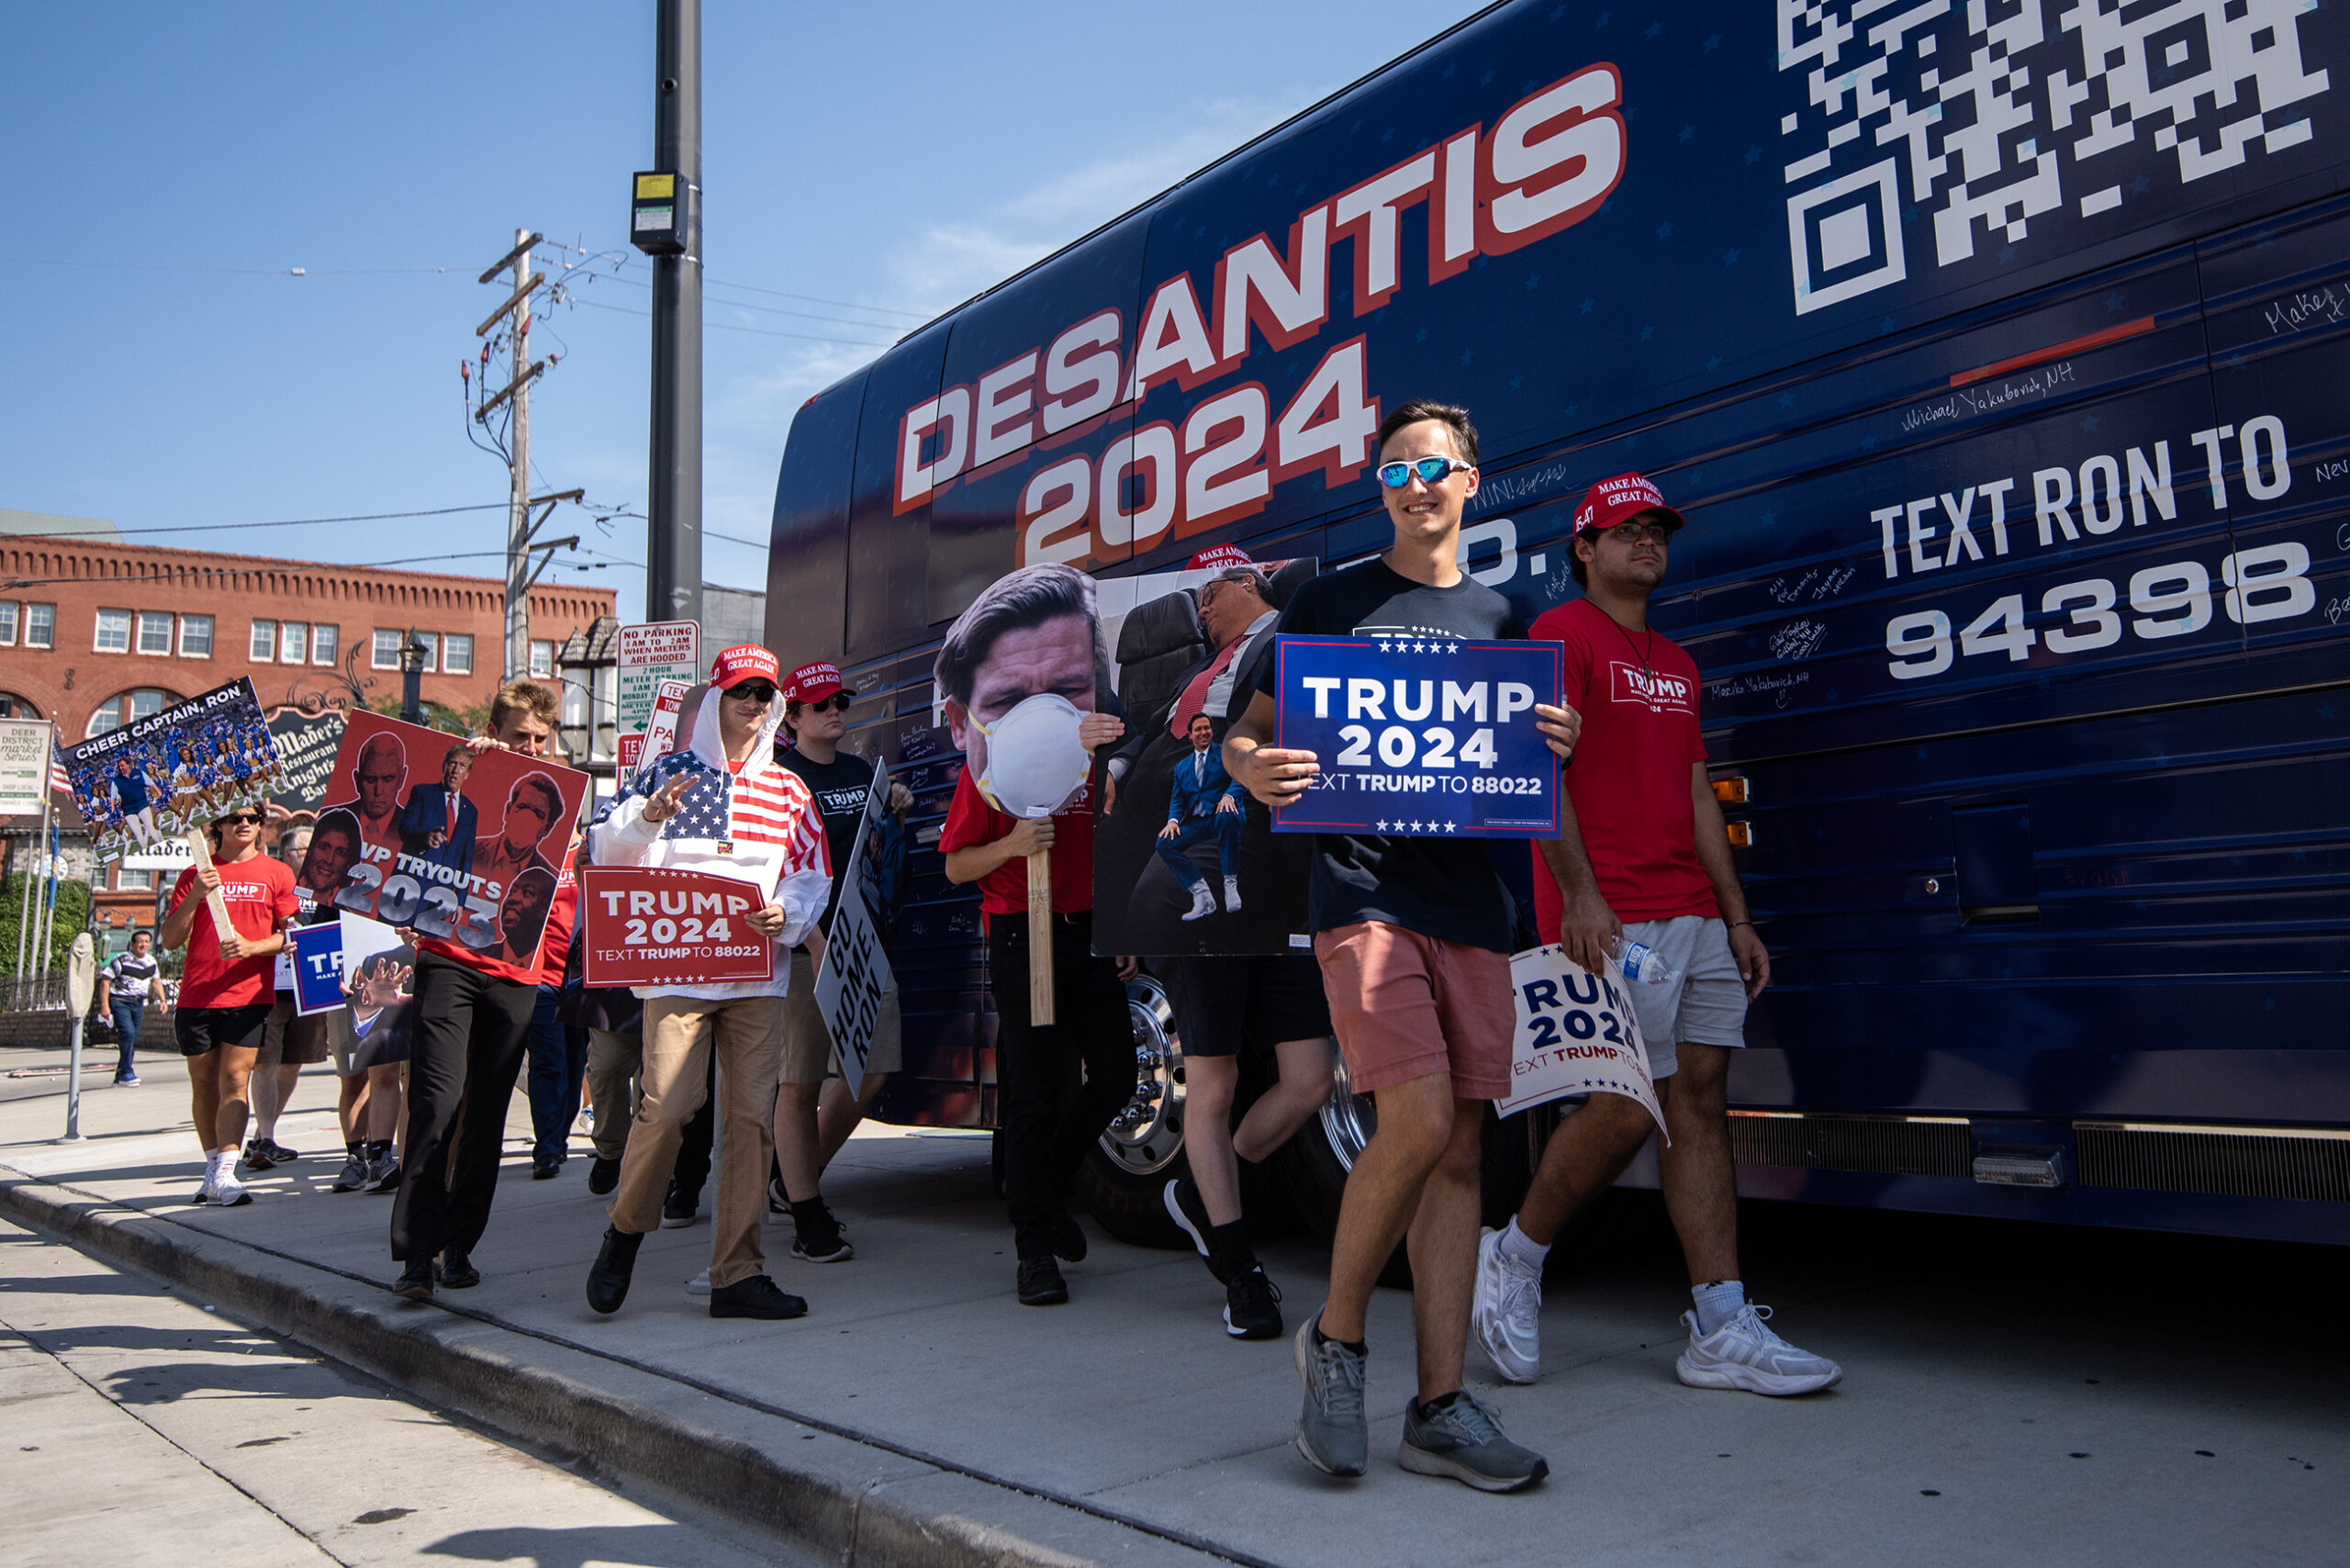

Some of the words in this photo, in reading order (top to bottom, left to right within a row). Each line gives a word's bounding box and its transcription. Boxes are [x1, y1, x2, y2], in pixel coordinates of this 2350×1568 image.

[896, 64, 1625, 510] DESANTIS
[1901, 397, 1961, 432] Michael
[2046, 362, 2075, 389] NH
[1019, 337, 1378, 570] 2024
[1598, 478, 1630, 495] MAKE
[1607, 490, 1641, 507] GREAT
[1870, 476, 2015, 579] TEXT
[2032, 439, 2177, 547] RON
[2191, 415, 2291, 510] TO
[1198, 548, 1225, 563] MAKE
[1885, 542, 2317, 680] 94398
[624, 631, 639, 640] NO
[643, 627, 692, 638] PARKING
[624, 647, 652, 655] WHEN
[655, 644, 691, 653] METERS
[631, 656, 648, 665] ARE
[650, 653, 687, 662] HOODED
[723, 648, 746, 662] MAKE
[747, 646, 778, 666] AMERICA
[649, 666, 672, 674] HOUR
[727, 658, 754, 671] GREAT
[754, 659, 775, 674] AGAIN
[796, 667, 818, 680] MAKE
[802, 675, 825, 689] GREAT
[1623, 668, 1687, 698] TRUMP
[1303, 677, 1535, 722] TRUMP
[11, 728, 36, 736] DEER
[75, 731, 129, 760] CHEER
[131, 701, 204, 738] CAPTAIN,
[205, 685, 241, 709] RON
[0, 743, 42, 754] market
[2, 736, 43, 745] DISTRICT
[272, 717, 343, 758] Mader's
[1337, 724, 1498, 768] 2024
[281, 742, 338, 772] Restaurant
[288, 759, 335, 790] night's
[1307, 772, 1350, 790] EXT
[1356, 774, 1436, 792] TRUMP
[1438, 776, 1468, 793] TO
[1471, 777, 1542, 795] 88022
[301, 783, 328, 802] Bar
[823, 790, 866, 806] TRUMP
[360, 842, 392, 863] VP
[397, 852, 502, 900] TRYOUTS
[334, 863, 499, 948] 2023
[599, 890, 750, 916] TRUMP
[624, 918, 732, 945] 2024
[830, 905, 852, 980] GO
[596, 948, 634, 961] TEXT
[638, 948, 691, 959] TRUMP
[692, 946, 713, 958] TO
[714, 946, 760, 957] 88022
[316, 972, 336, 980] MAKE
[832, 917, 876, 1061] HOME,
[1515, 973, 1636, 1029] RUMP
[852, 967, 882, 1071] RON
[1528, 1009, 1639, 1059] 2024
[1514, 1053, 1549, 1076] EXT
[1553, 1046, 1618, 1062] TRUMP
[1619, 1049, 1636, 1069] TO
